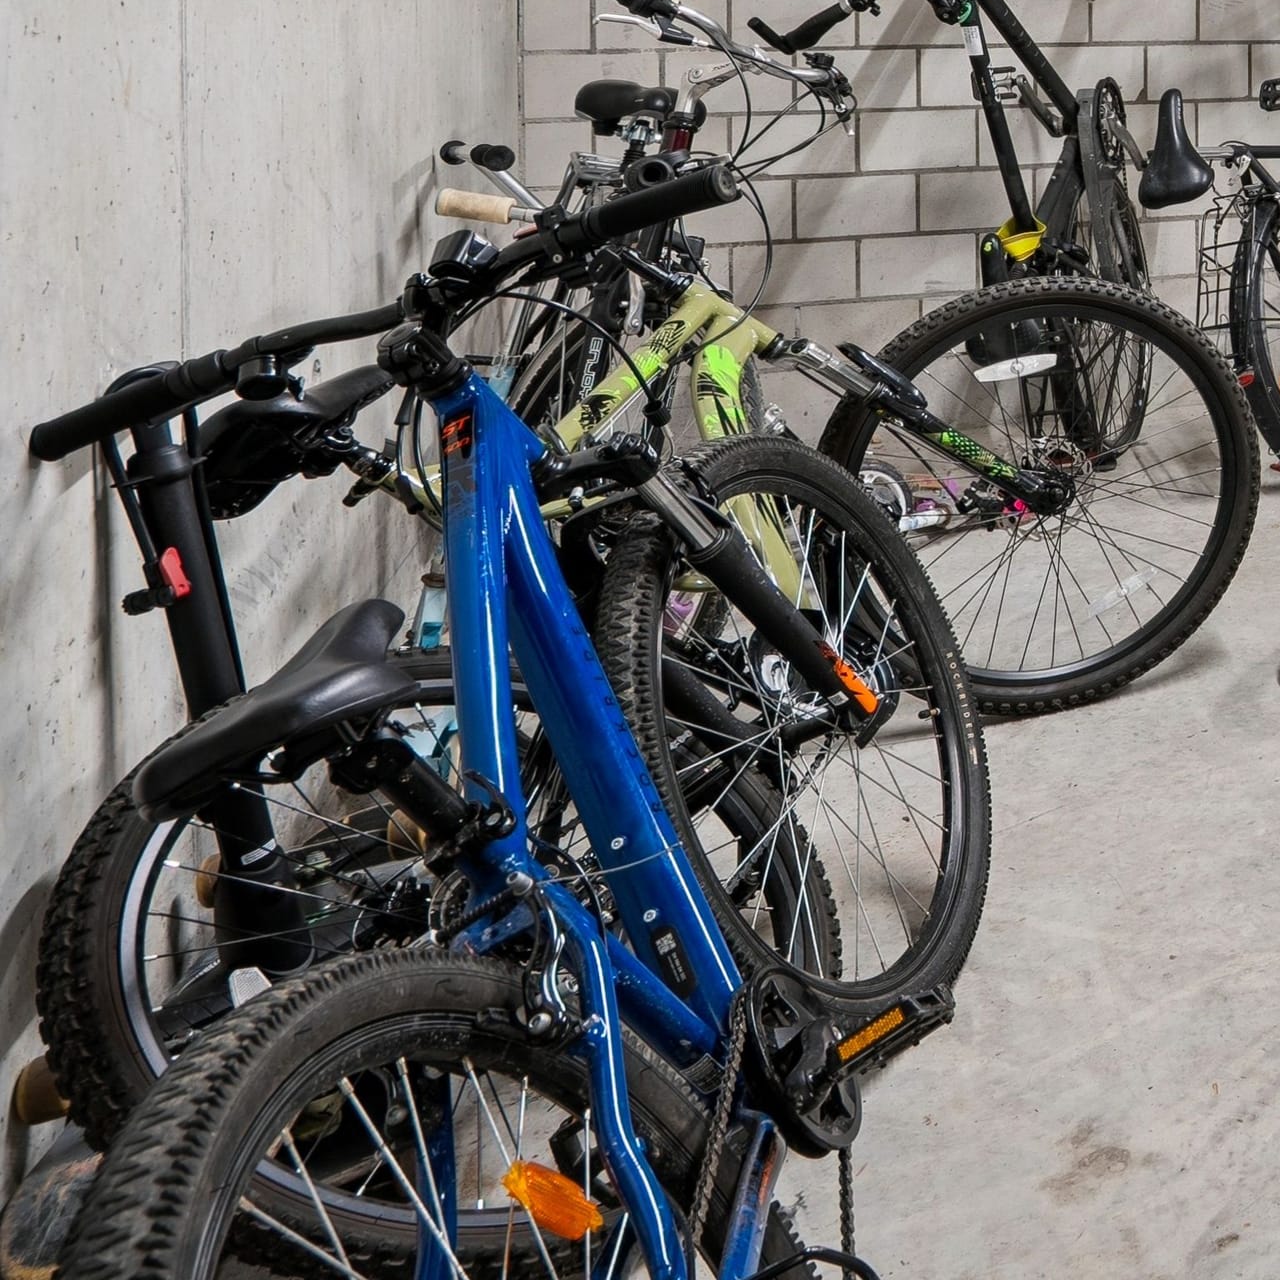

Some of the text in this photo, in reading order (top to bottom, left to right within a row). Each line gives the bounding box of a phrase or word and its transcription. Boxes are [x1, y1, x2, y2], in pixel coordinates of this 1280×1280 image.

[578, 336, 604, 400] ENJOY
[441, 414, 471, 439] ST
[945, 651, 975, 739] ROCKRIDER
